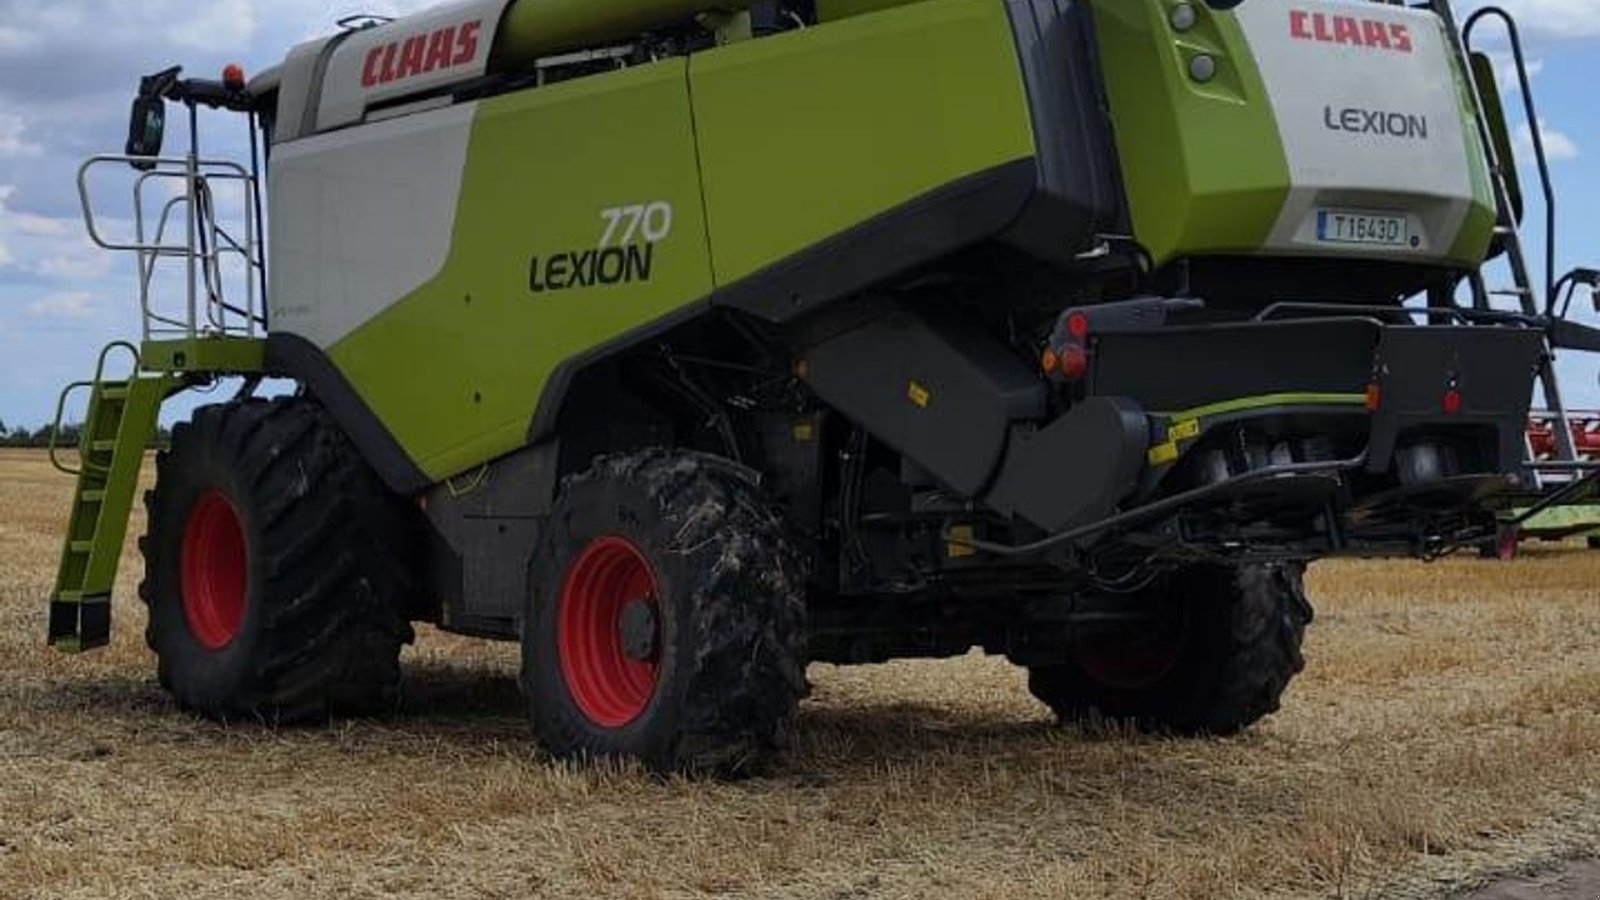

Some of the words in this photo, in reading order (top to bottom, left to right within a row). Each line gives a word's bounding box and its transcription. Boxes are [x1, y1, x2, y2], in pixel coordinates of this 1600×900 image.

[361, 20, 481, 87] CLAAS
[1290, 10, 1412, 52] CLAAS
[1324, 105, 1427, 138] LEXION
[600, 201, 672, 247] 770
[530, 243, 653, 292] LEXION
